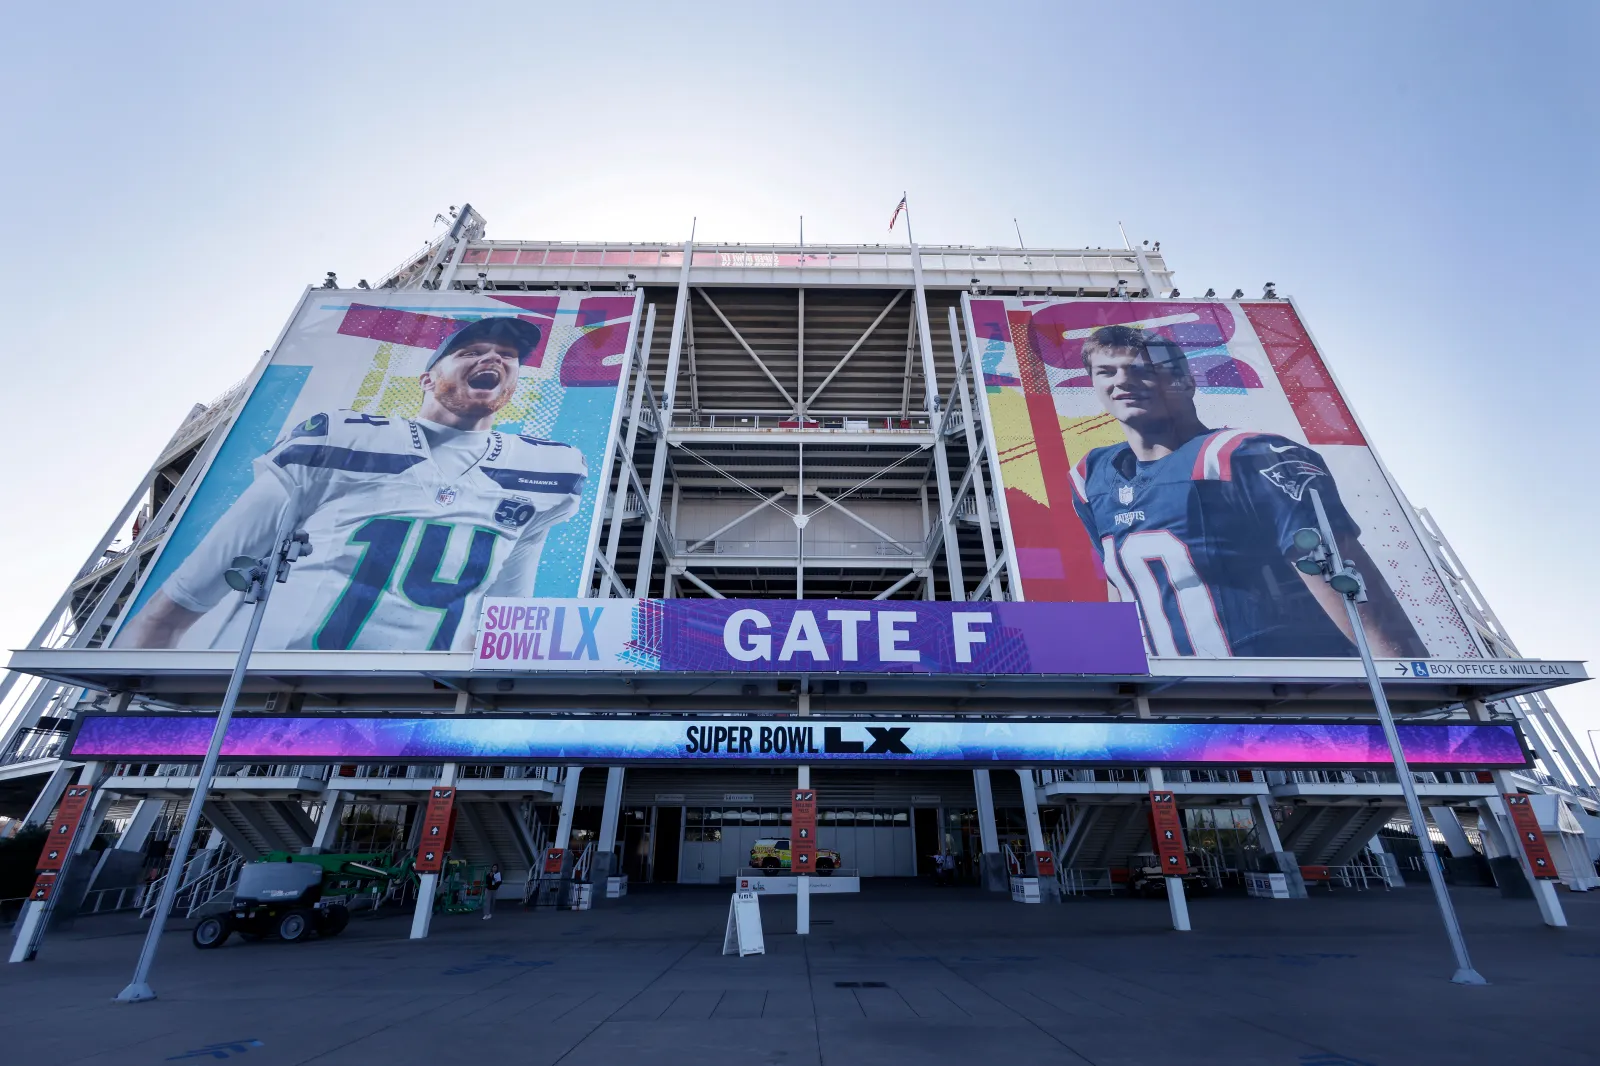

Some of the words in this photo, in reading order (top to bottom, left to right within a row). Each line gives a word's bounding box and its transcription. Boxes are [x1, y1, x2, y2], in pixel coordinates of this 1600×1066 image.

[518, 478, 558, 486] SEAHAWKS
[439, 494, 452, 503] NFL
[312, 515, 500, 650] 14
[485, 605, 550, 631] SUPER
[479, 631, 544, 661] BOWL
[547, 606, 606, 661] LX
[723, 608, 921, 663] GATE
[952, 611, 993, 663] F
[1430, 664, 1455, 675] BOX
[1456, 664, 1497, 675] OFFICE
[1498, 664, 1509, 675] &
[1509, 664, 1539, 675] WILL
[1540, 665, 1570, 675] CALL
[685, 725, 752, 754] SUPER
[759, 726, 819, 754] BOWL
[824, 727, 914, 754] LX
